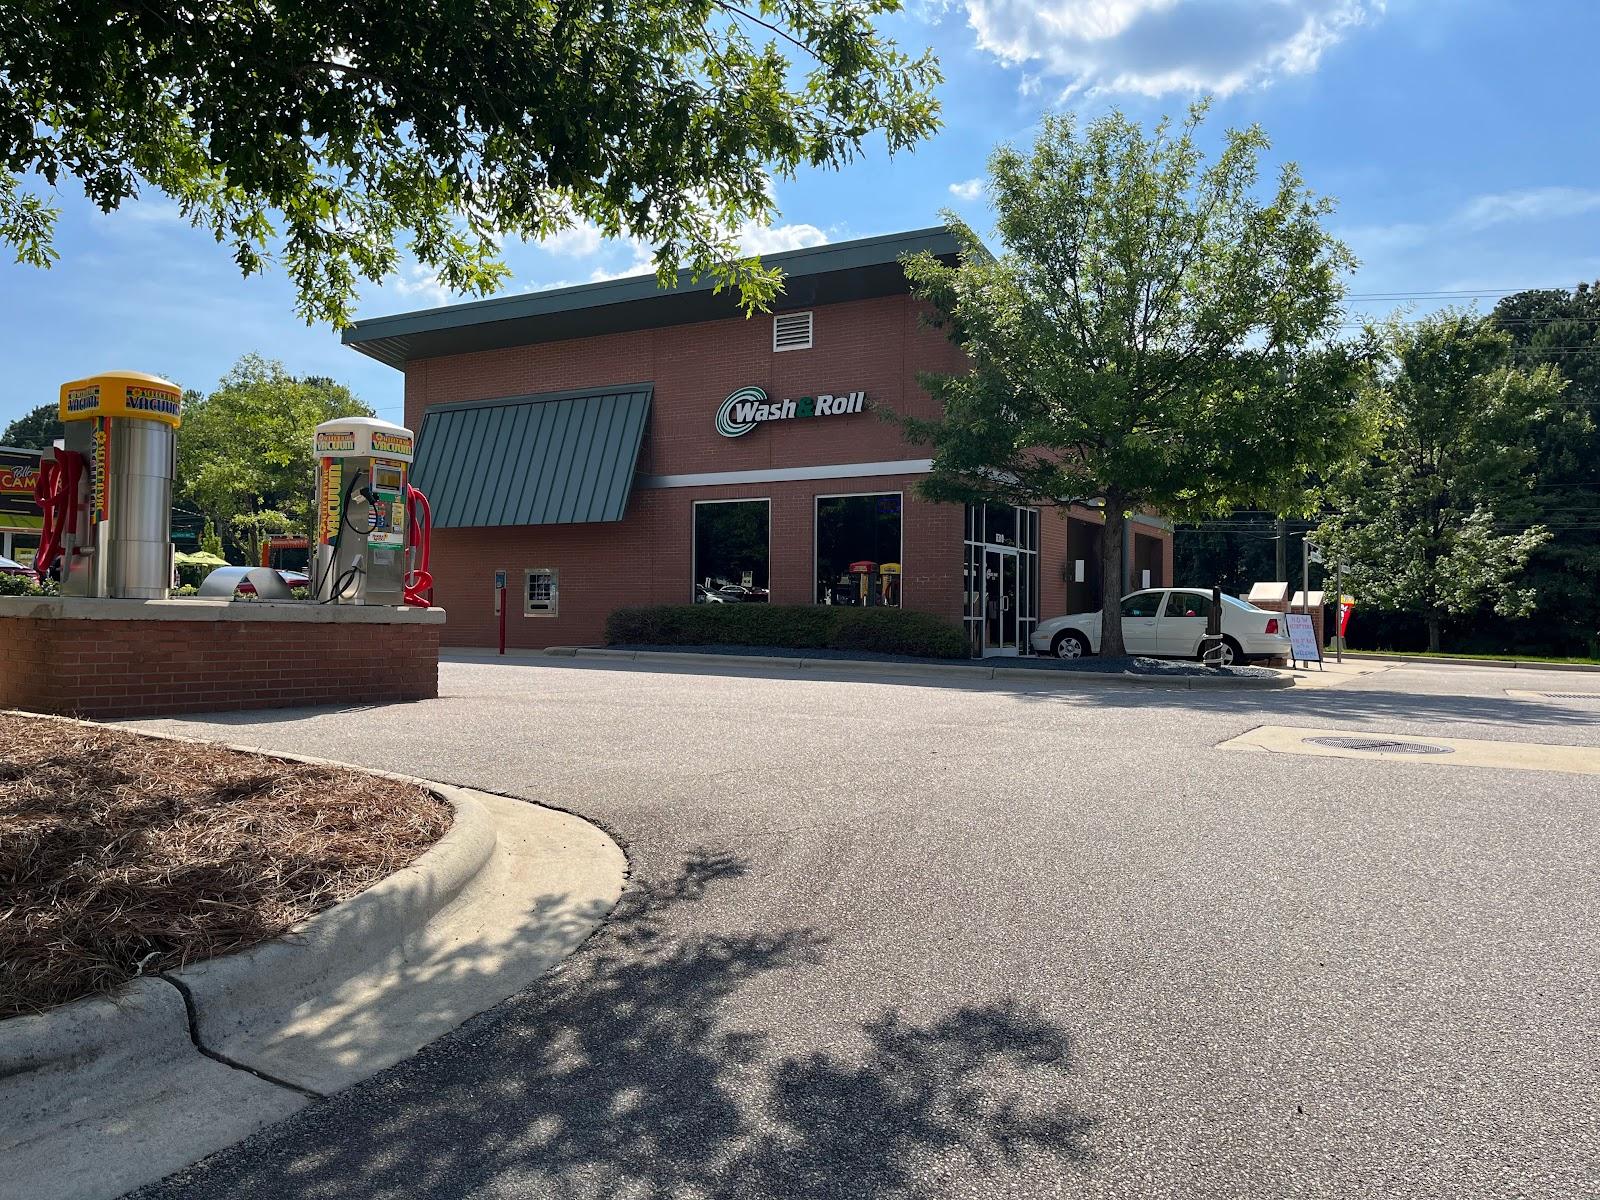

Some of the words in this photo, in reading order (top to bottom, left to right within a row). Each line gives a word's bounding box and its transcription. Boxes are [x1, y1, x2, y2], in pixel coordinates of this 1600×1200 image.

[11, 465, 32, 478] Pollo
[2, 475, 37, 488] CAM
[327, 464, 341, 538] VACUUM
